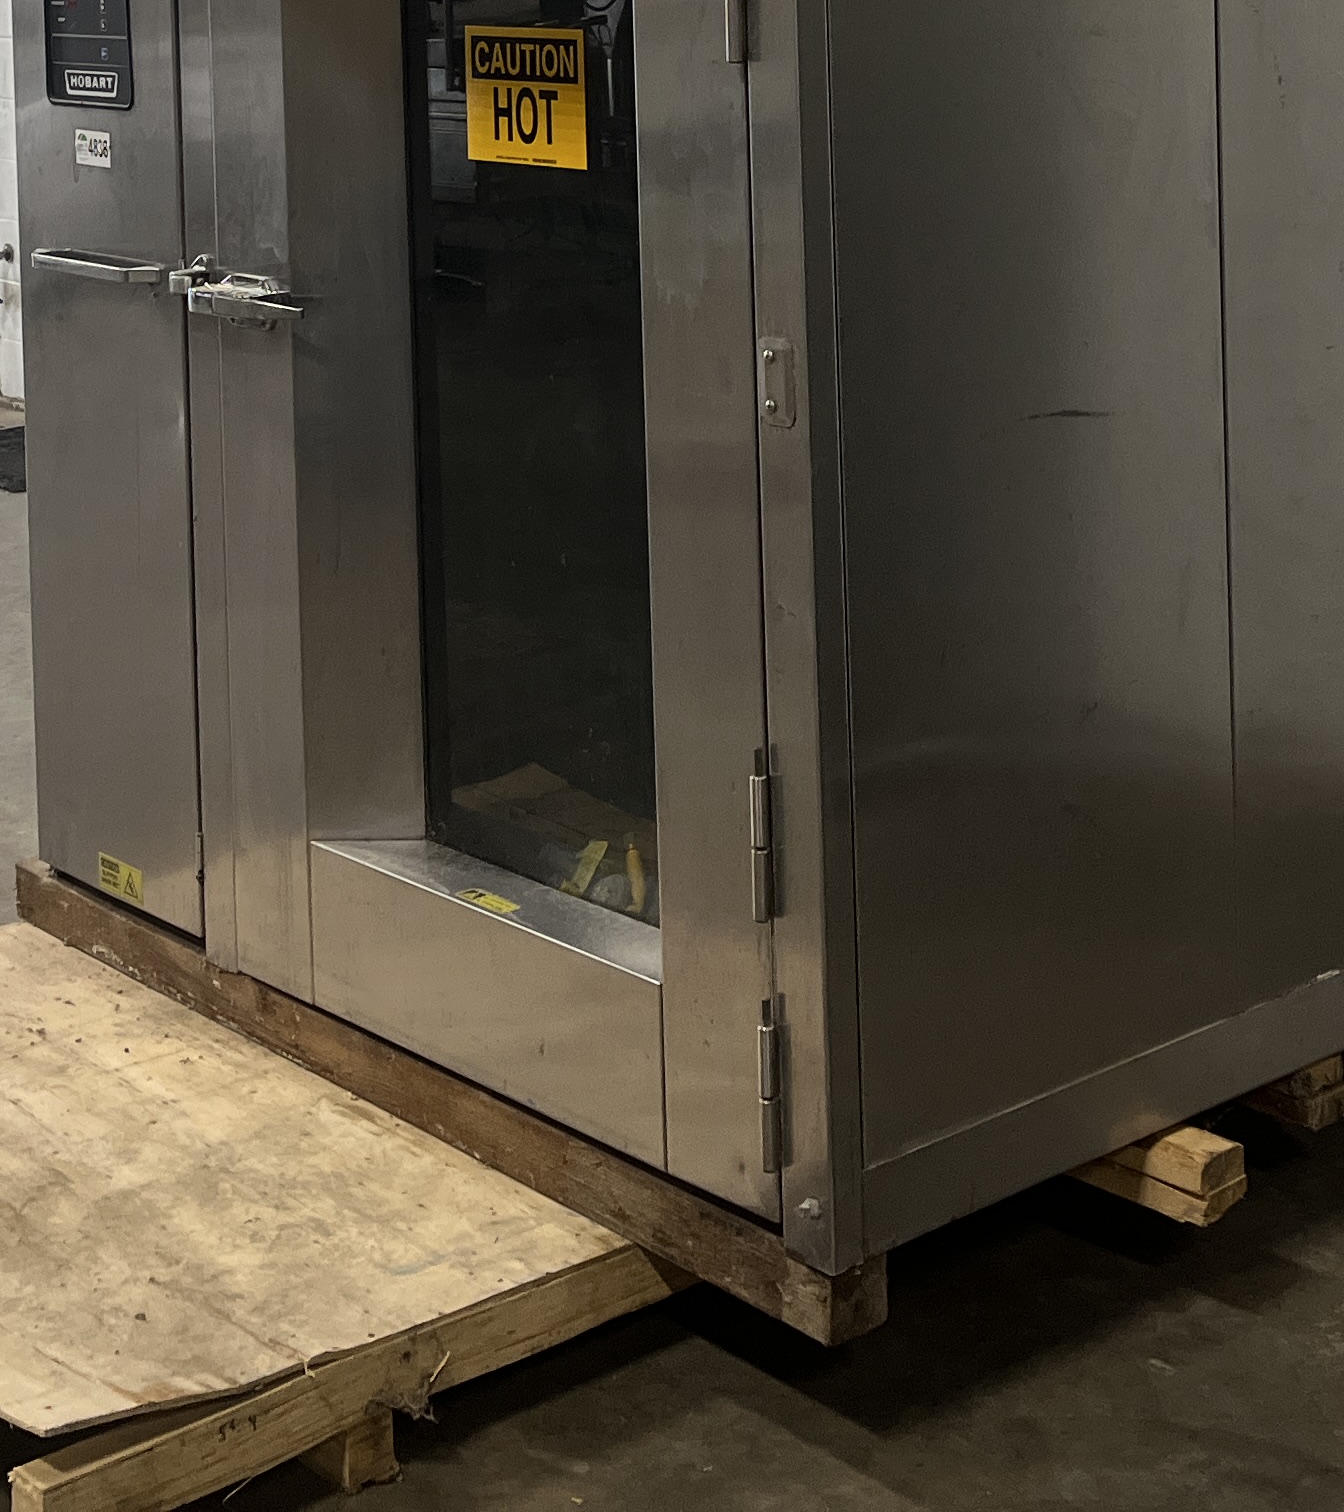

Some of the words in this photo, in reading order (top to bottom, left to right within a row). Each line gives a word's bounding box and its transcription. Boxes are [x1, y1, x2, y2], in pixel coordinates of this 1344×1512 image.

[474, 40, 576, 79] CAUTION
[70, 74, 114, 90] HOBART
[492, 85, 560, 146] HOT
